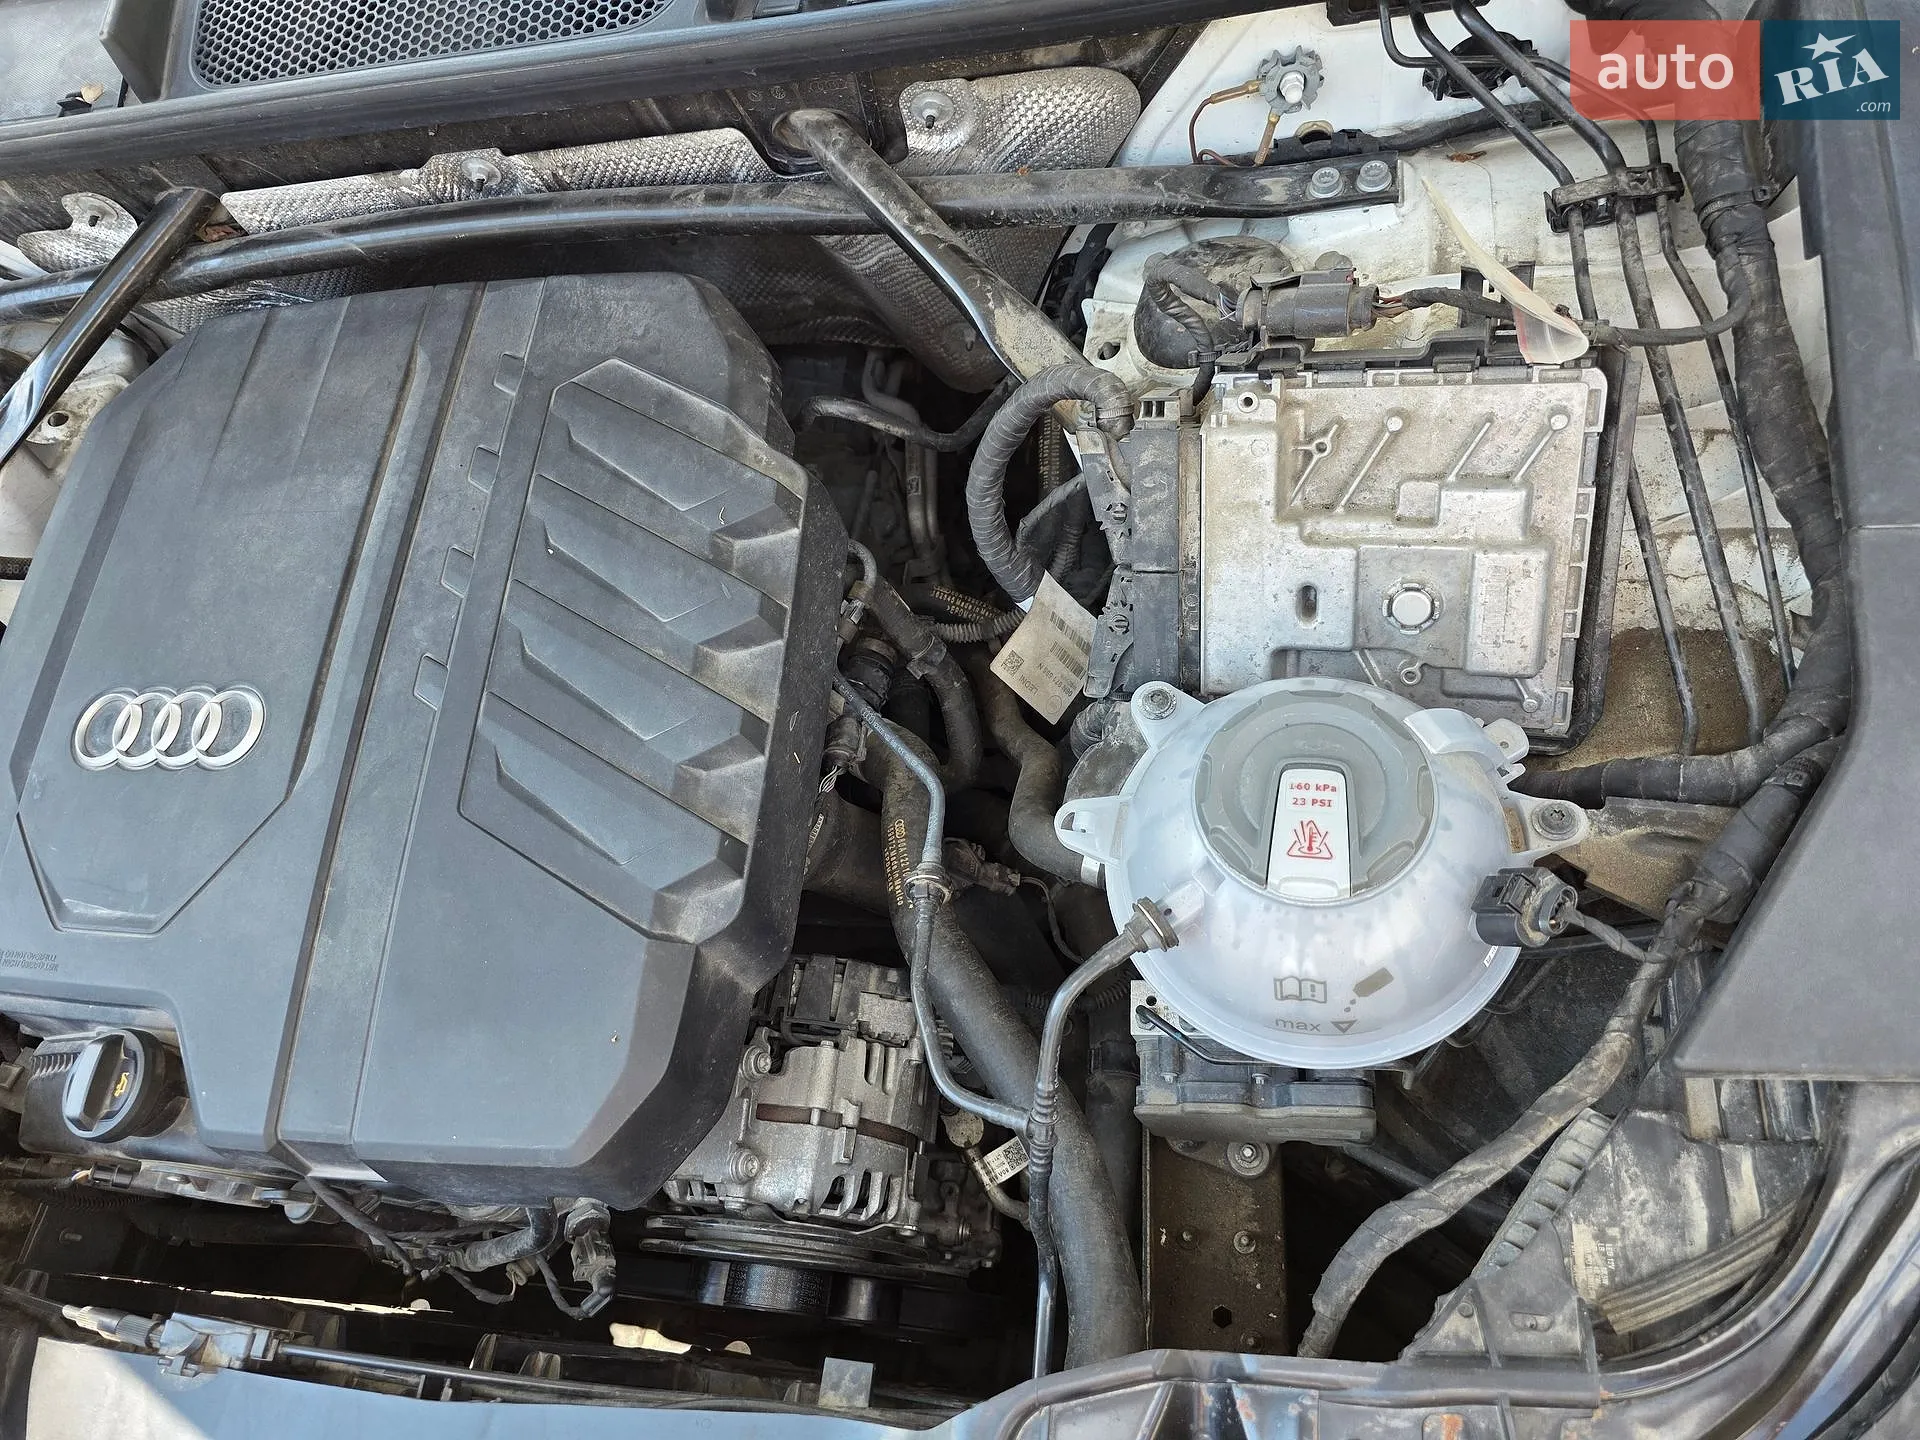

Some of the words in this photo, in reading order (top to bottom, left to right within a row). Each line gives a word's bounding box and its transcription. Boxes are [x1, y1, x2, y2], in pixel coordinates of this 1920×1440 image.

[1018, 674, 1039, 695] LEONI
[1289, 782, 1310, 791] 160
[1315, 783, 1337, 793] kPa
[1292, 797, 1306, 806] 23
[1311, 798, 1333, 808] PSI
[888, 850, 899, 870] Made
[894, 878, 904, 905] Mexico
[1275, 1018, 1321, 1032] max
